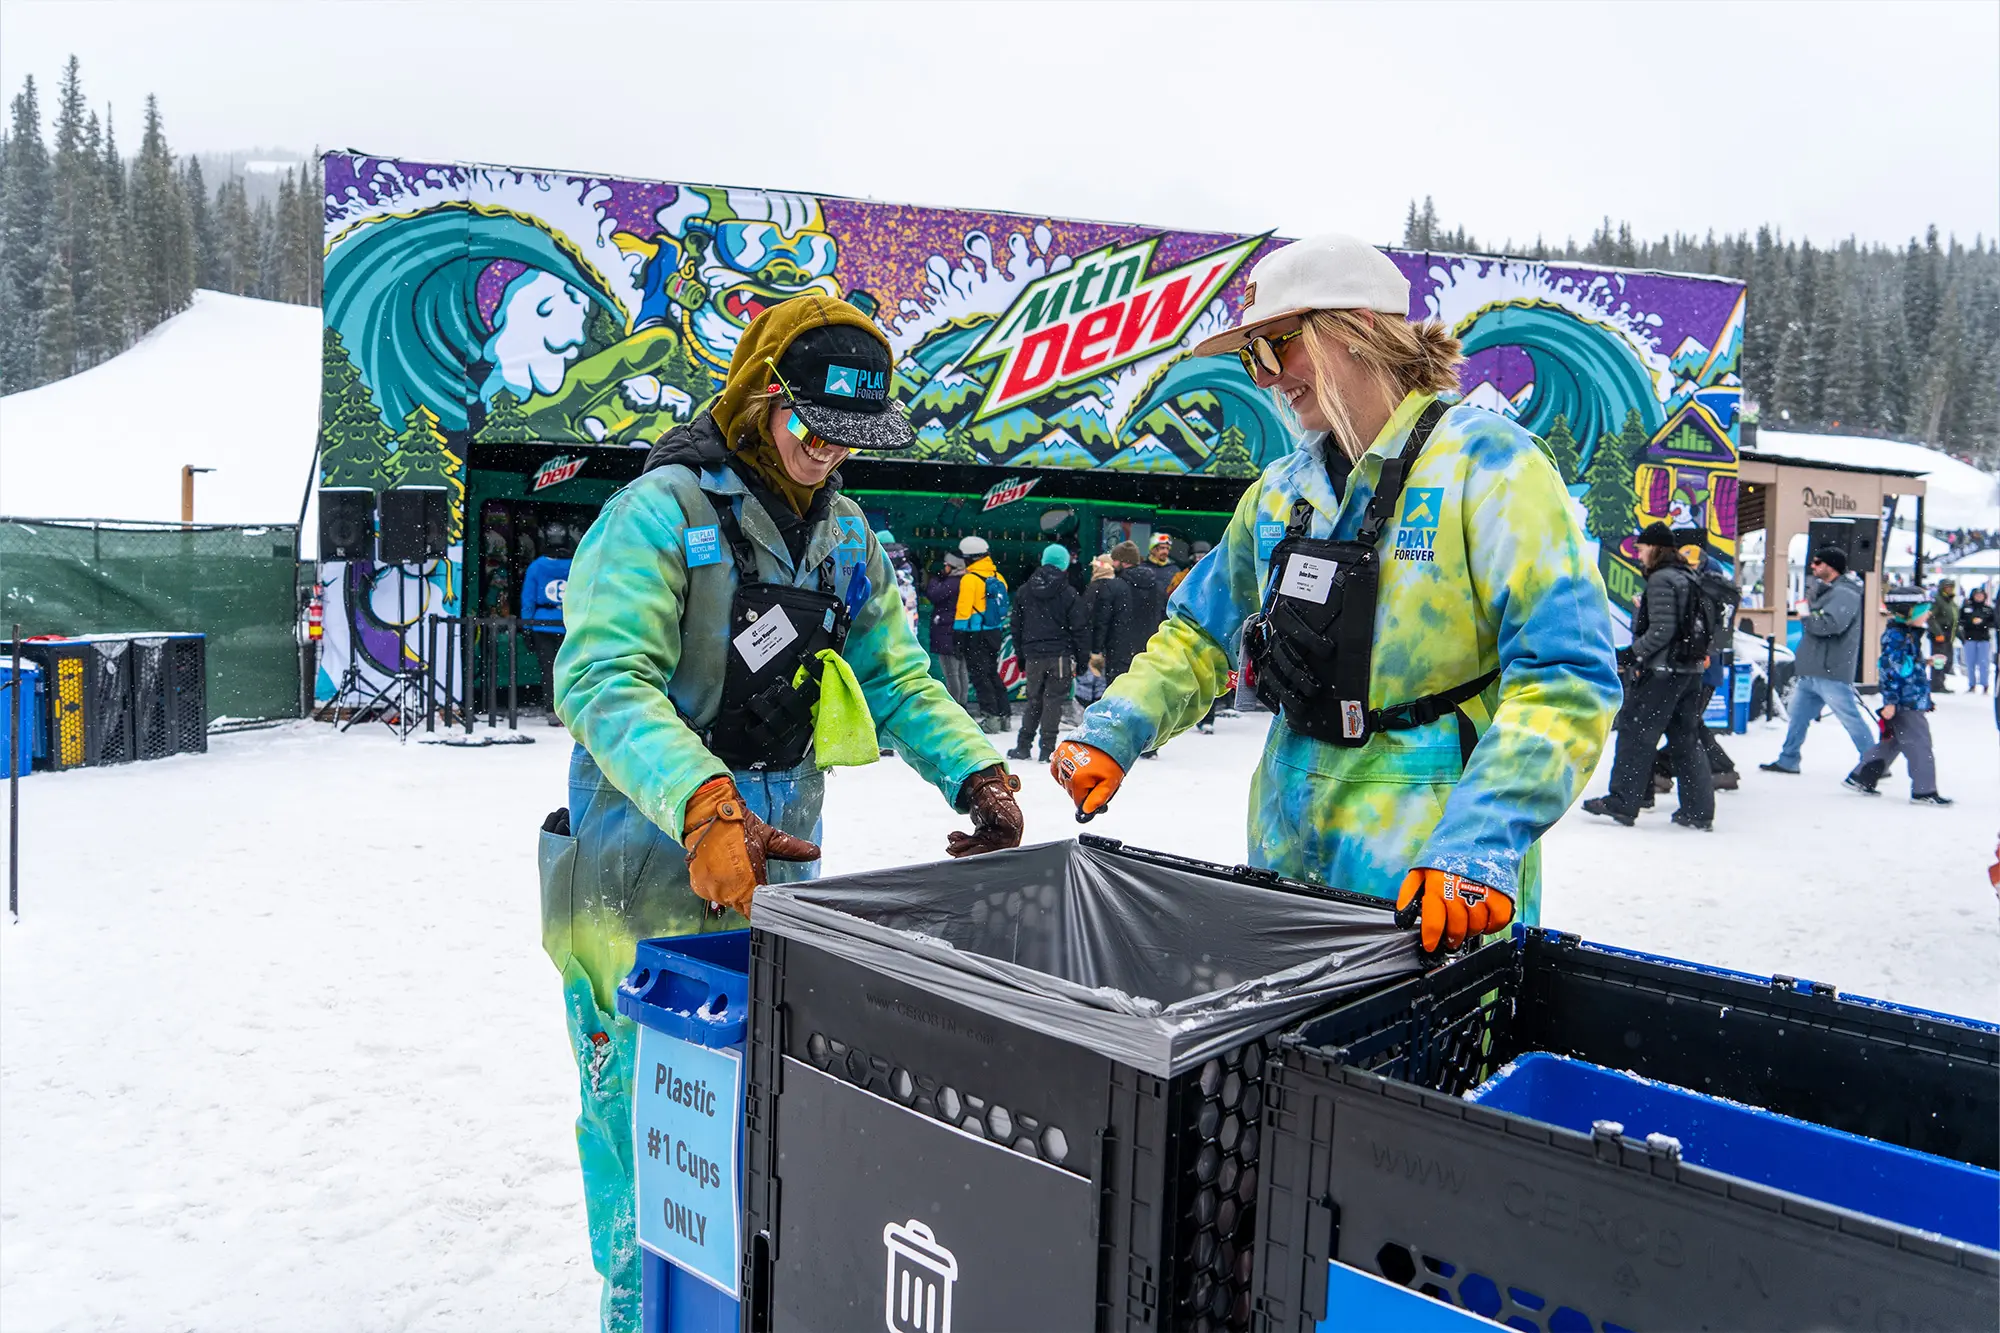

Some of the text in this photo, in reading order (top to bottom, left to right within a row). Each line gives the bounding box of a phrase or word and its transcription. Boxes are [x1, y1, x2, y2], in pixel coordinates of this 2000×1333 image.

[700, 530, 714, 538] PLAY
[1396, 529, 1438, 549] PLAY
[691, 544, 715, 554] RECYCLING
[698, 553, 710, 561] TEAM
[1394, 549, 1435, 562] FOREVER
[1607, 560, 1642, 602] DO
[655, 1062, 717, 1118] Plastic
[647, 1126, 721, 1190] #1 Cups
[663, 1197, 708, 1247] ONLY
